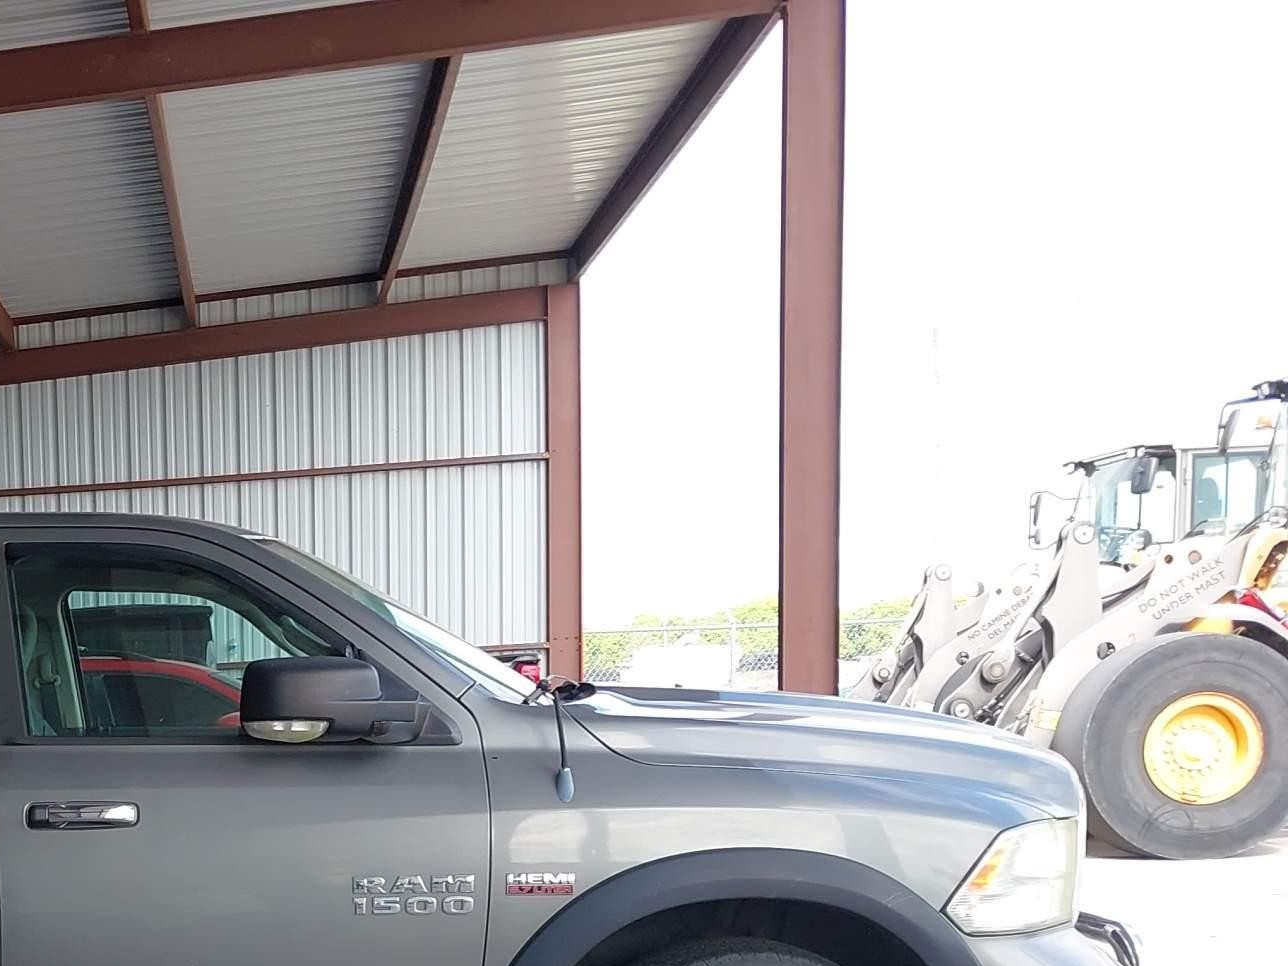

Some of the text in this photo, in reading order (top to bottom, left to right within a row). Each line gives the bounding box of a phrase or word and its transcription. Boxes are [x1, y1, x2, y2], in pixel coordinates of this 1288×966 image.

[1138, 556, 1224, 613] DO NOT WALK
[1152, 570, 1225, 620] UNDER MAST
[352, 874, 475, 894] RAM
[506, 872, 576, 885] HEMI
[352, 895, 475, 915] 1500
